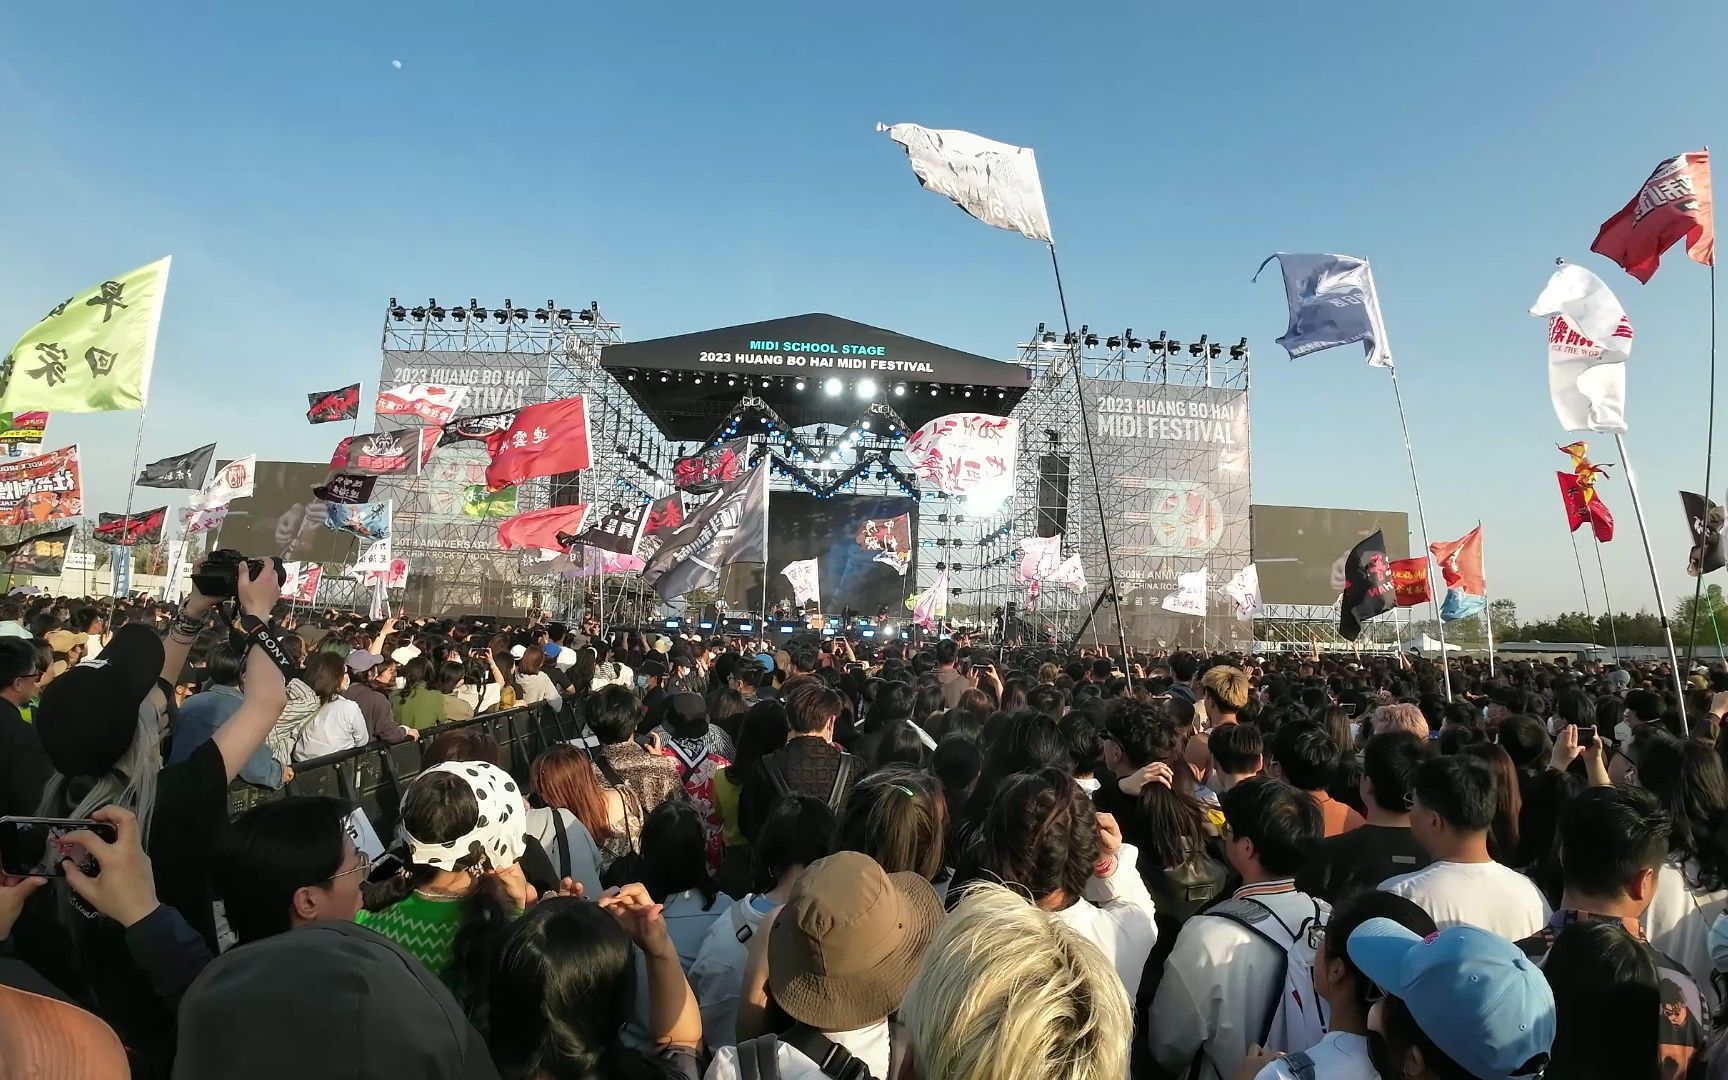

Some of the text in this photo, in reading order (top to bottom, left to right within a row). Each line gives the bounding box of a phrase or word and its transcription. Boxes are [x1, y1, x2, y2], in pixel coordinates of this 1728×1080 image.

[750, 340, 886, 356] MIDI SCHOOL STAGE
[699, 352, 934, 373] 2023 HUANG BO HAI MIDI FESTIVAL
[394, 367, 531, 386] 2023 HUANG BO HAI
[1098, 396, 1234, 420] 2023 HUANG BO HAI
[1097, 414, 1235, 444] MIDI FESTIVAL
[394, 538, 492, 550] 30TH ANNIVERSARY
[456, 552, 491, 561] SCHOOL
[1120, 570, 1144, 578] 30TH
[258, 631, 290, 666] SONY
